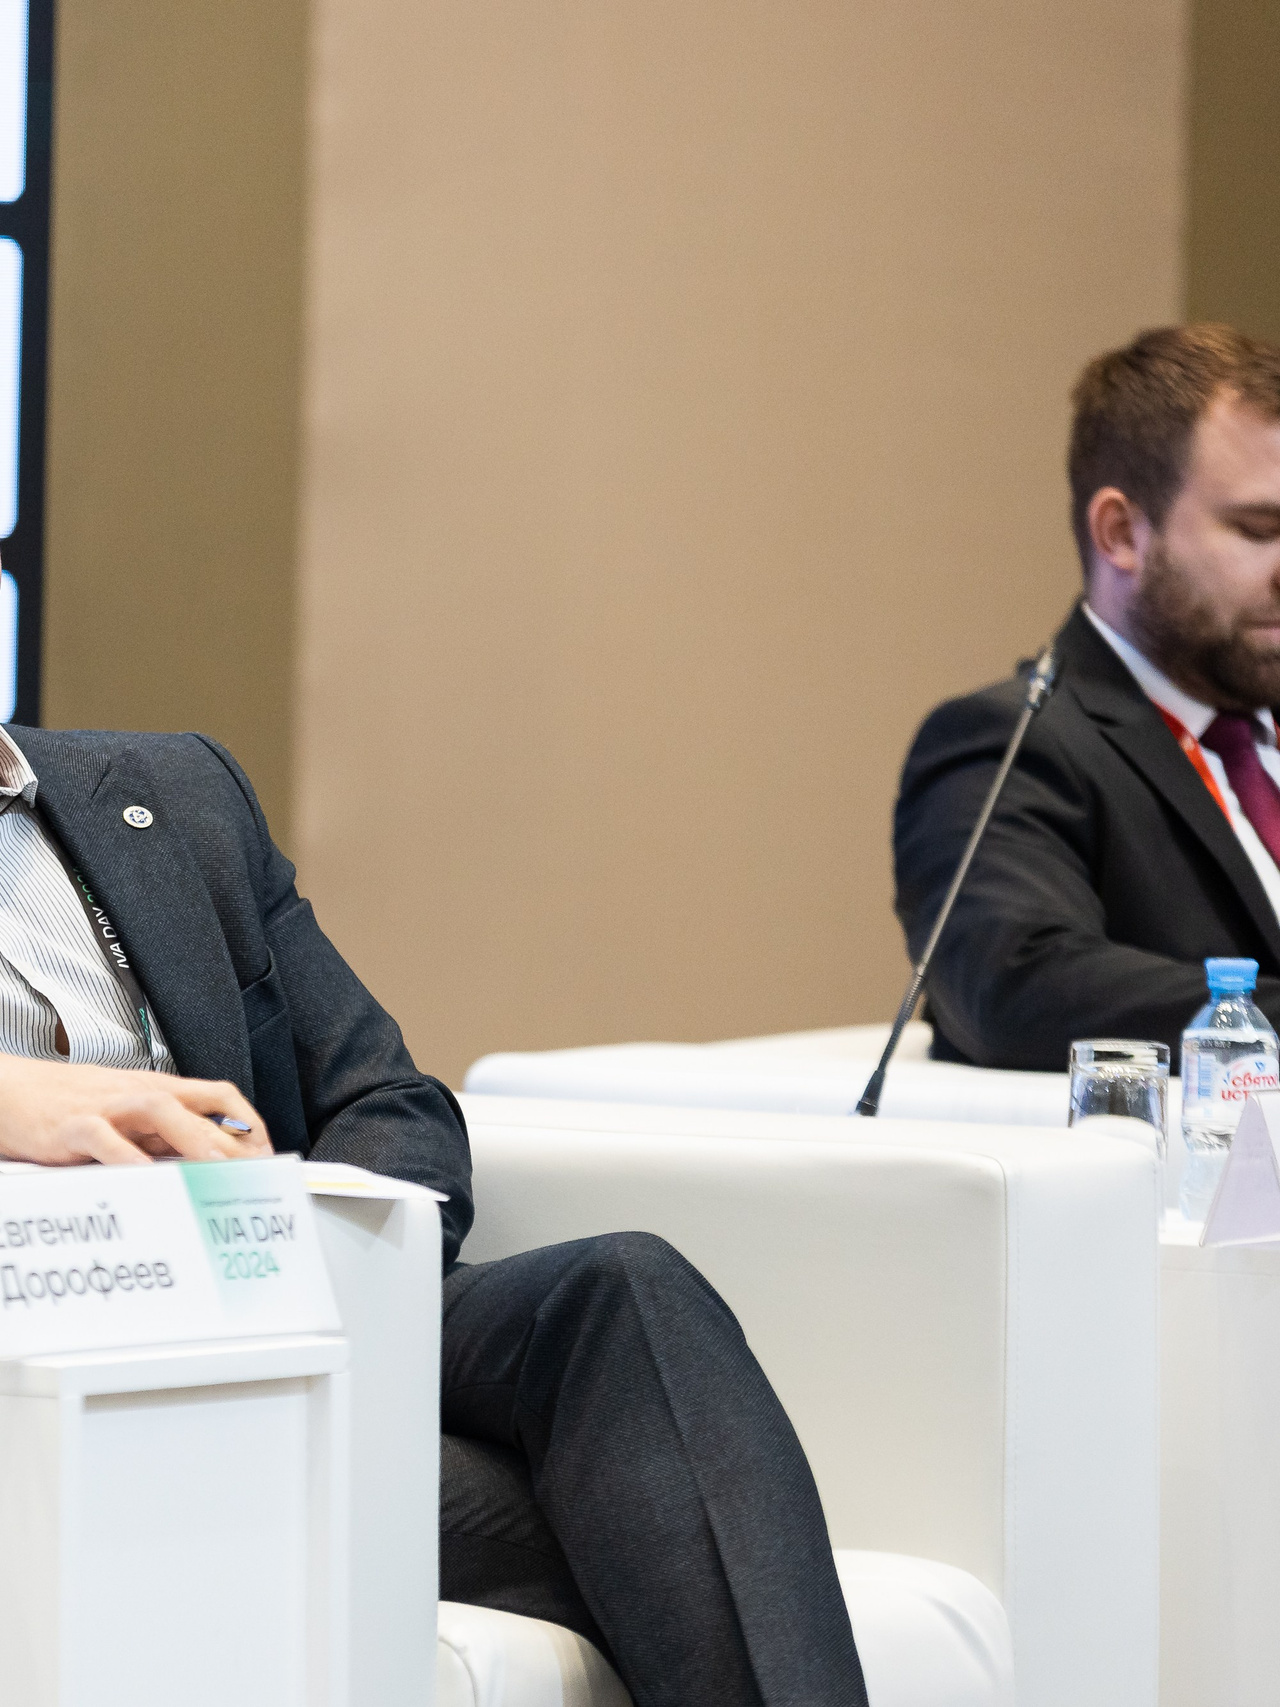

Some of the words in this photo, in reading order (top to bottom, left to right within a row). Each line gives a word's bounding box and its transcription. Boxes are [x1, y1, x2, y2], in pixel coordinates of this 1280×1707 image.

[207, 1216, 250, 1245] IVA
[251, 1213, 296, 1242] DAY
[220, 1250, 280, 1281] 2024
[0, 1259, 174, 1310] Дорофеев
